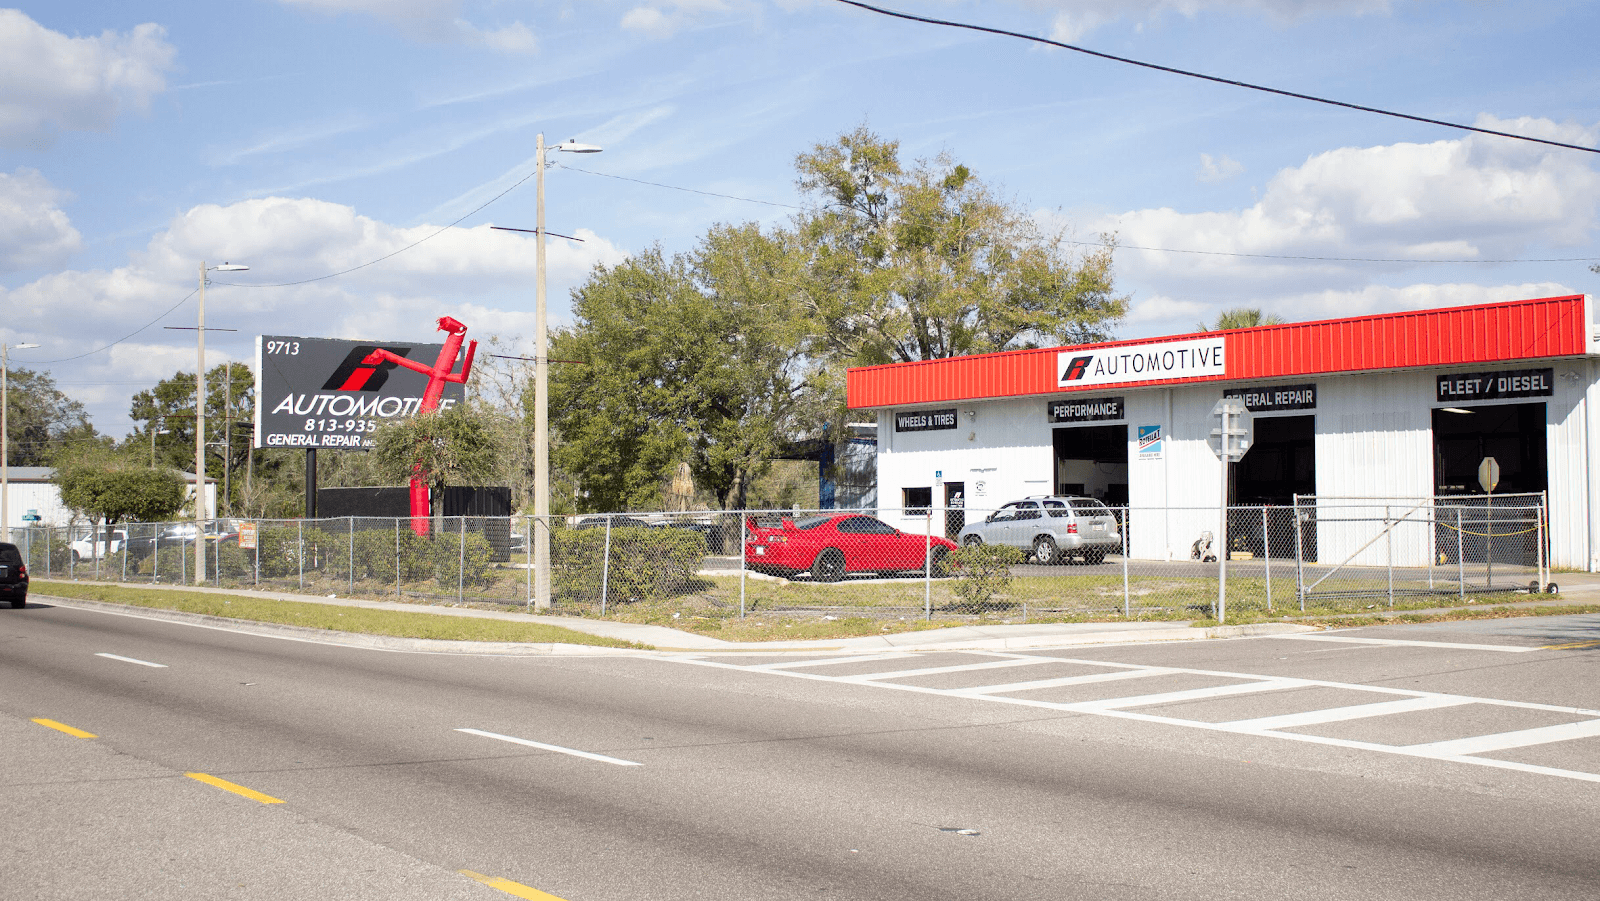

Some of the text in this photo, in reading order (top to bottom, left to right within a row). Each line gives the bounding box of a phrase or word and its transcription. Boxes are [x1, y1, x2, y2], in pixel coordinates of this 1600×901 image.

[267, 341, 300, 355] 9713
[1095, 346, 1222, 376] AUTOMOTIVE
[1440, 374, 1548, 396] FLEET / DIESEL
[1274, 389, 1313, 405] REPAIR
[272, 393, 456, 417] AUTOMOTIE
[1054, 403, 1118, 418] PERFORMANCE
[898, 414, 954, 428] WHEELS & TIRES
[267, 434, 319, 446] GENERAL
[321, 434, 361, 447] REPAIR
